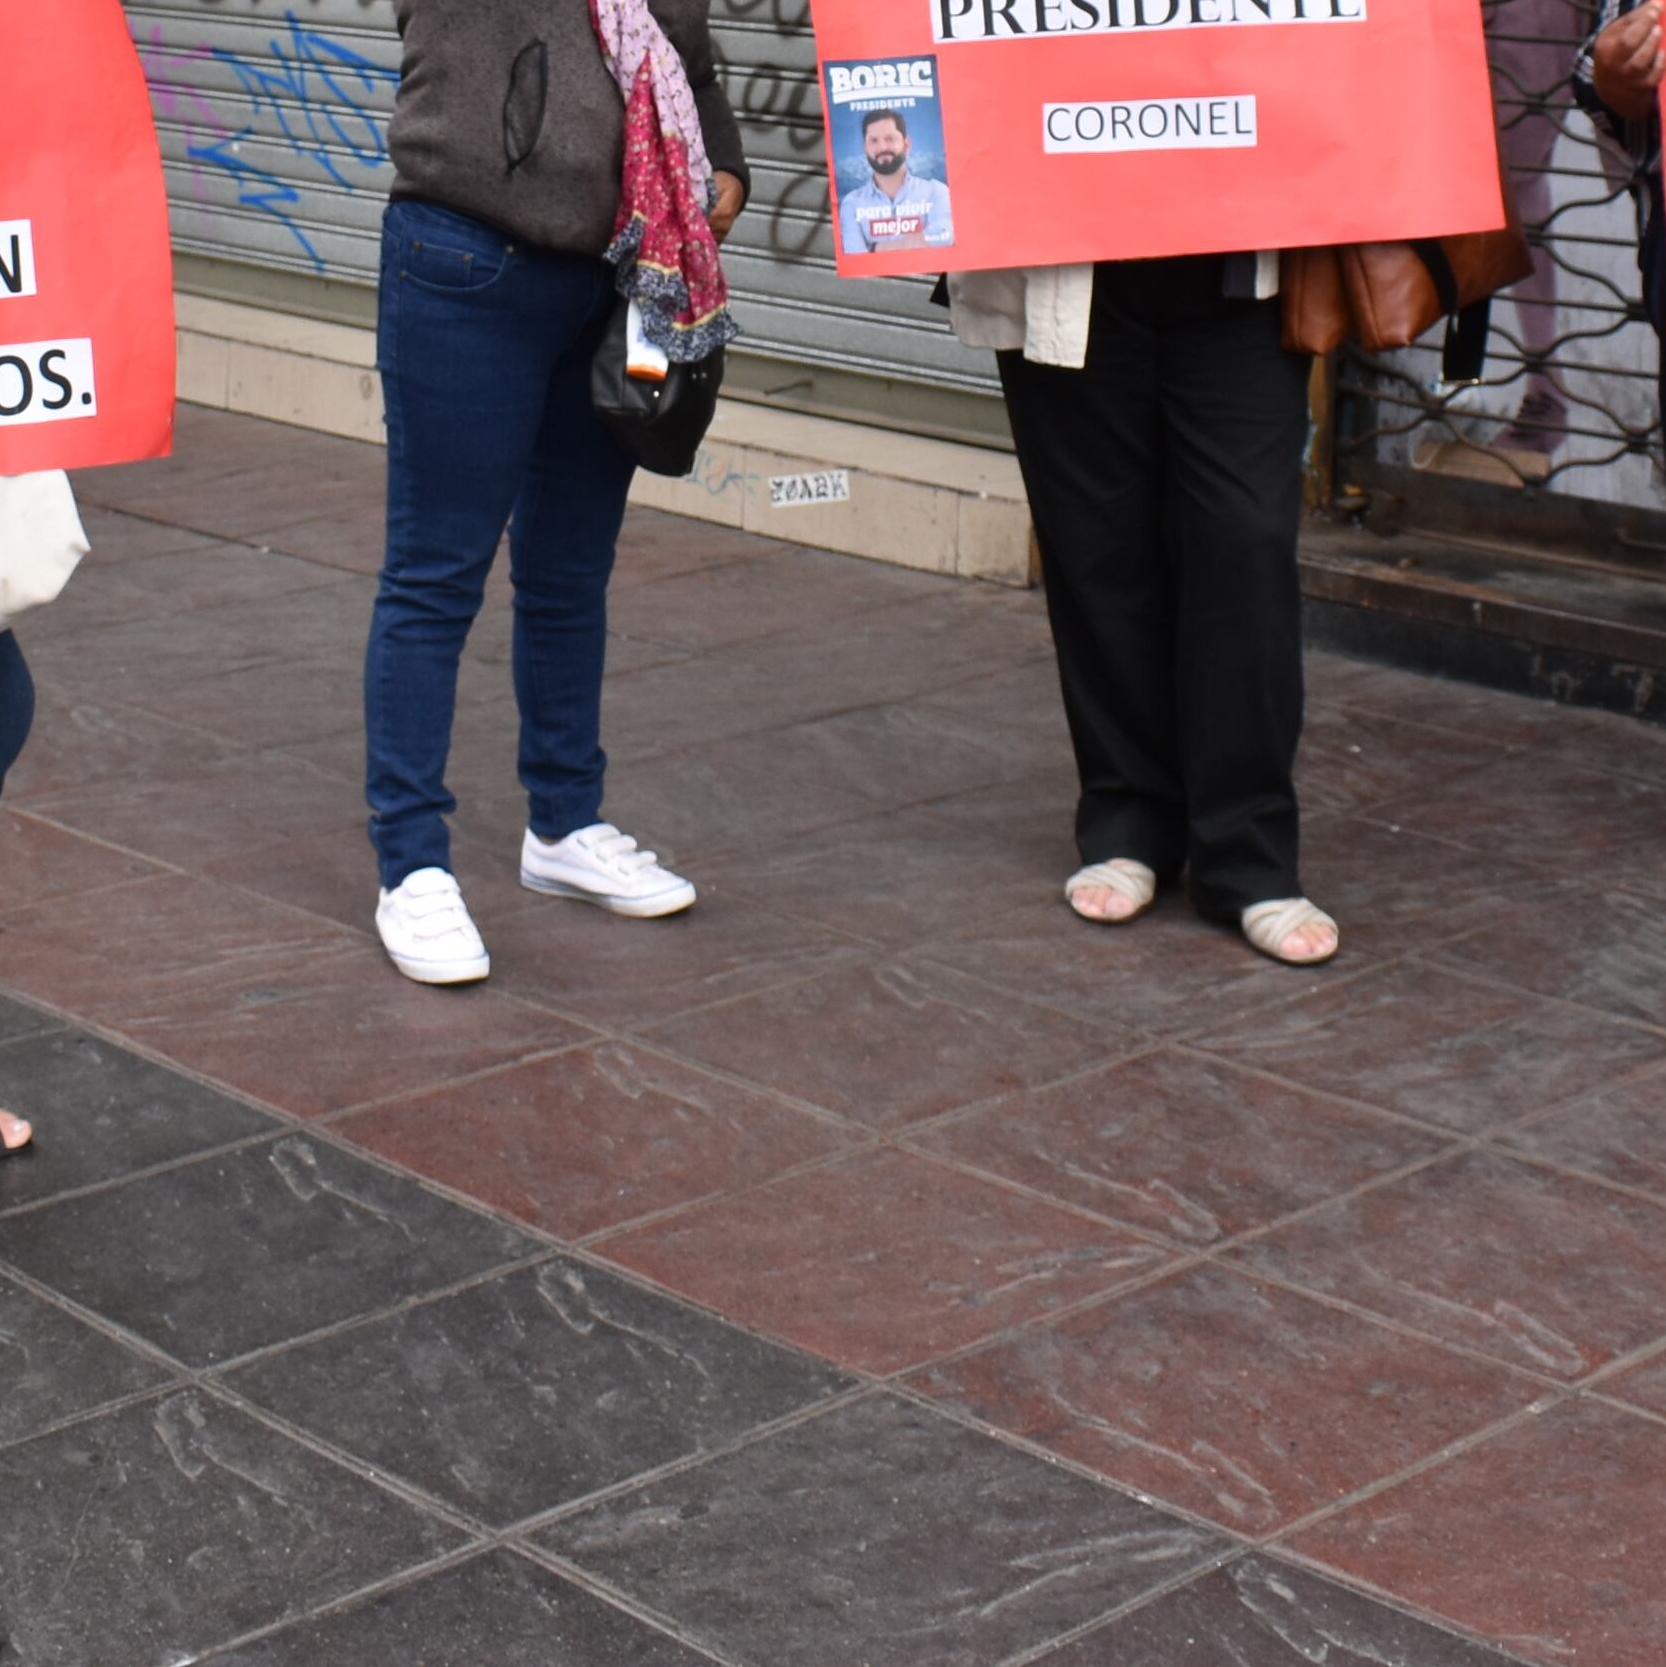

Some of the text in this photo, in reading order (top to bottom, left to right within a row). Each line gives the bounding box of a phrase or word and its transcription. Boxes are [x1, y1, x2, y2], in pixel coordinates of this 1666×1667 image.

[829, 60, 933, 93] BORIC
[849, 97, 916, 112] PRESIDENTE
[1046, 102, 1253, 143] CORONEL
[856, 199, 934, 223] para vivir
[872, 218, 919, 236] mejor
